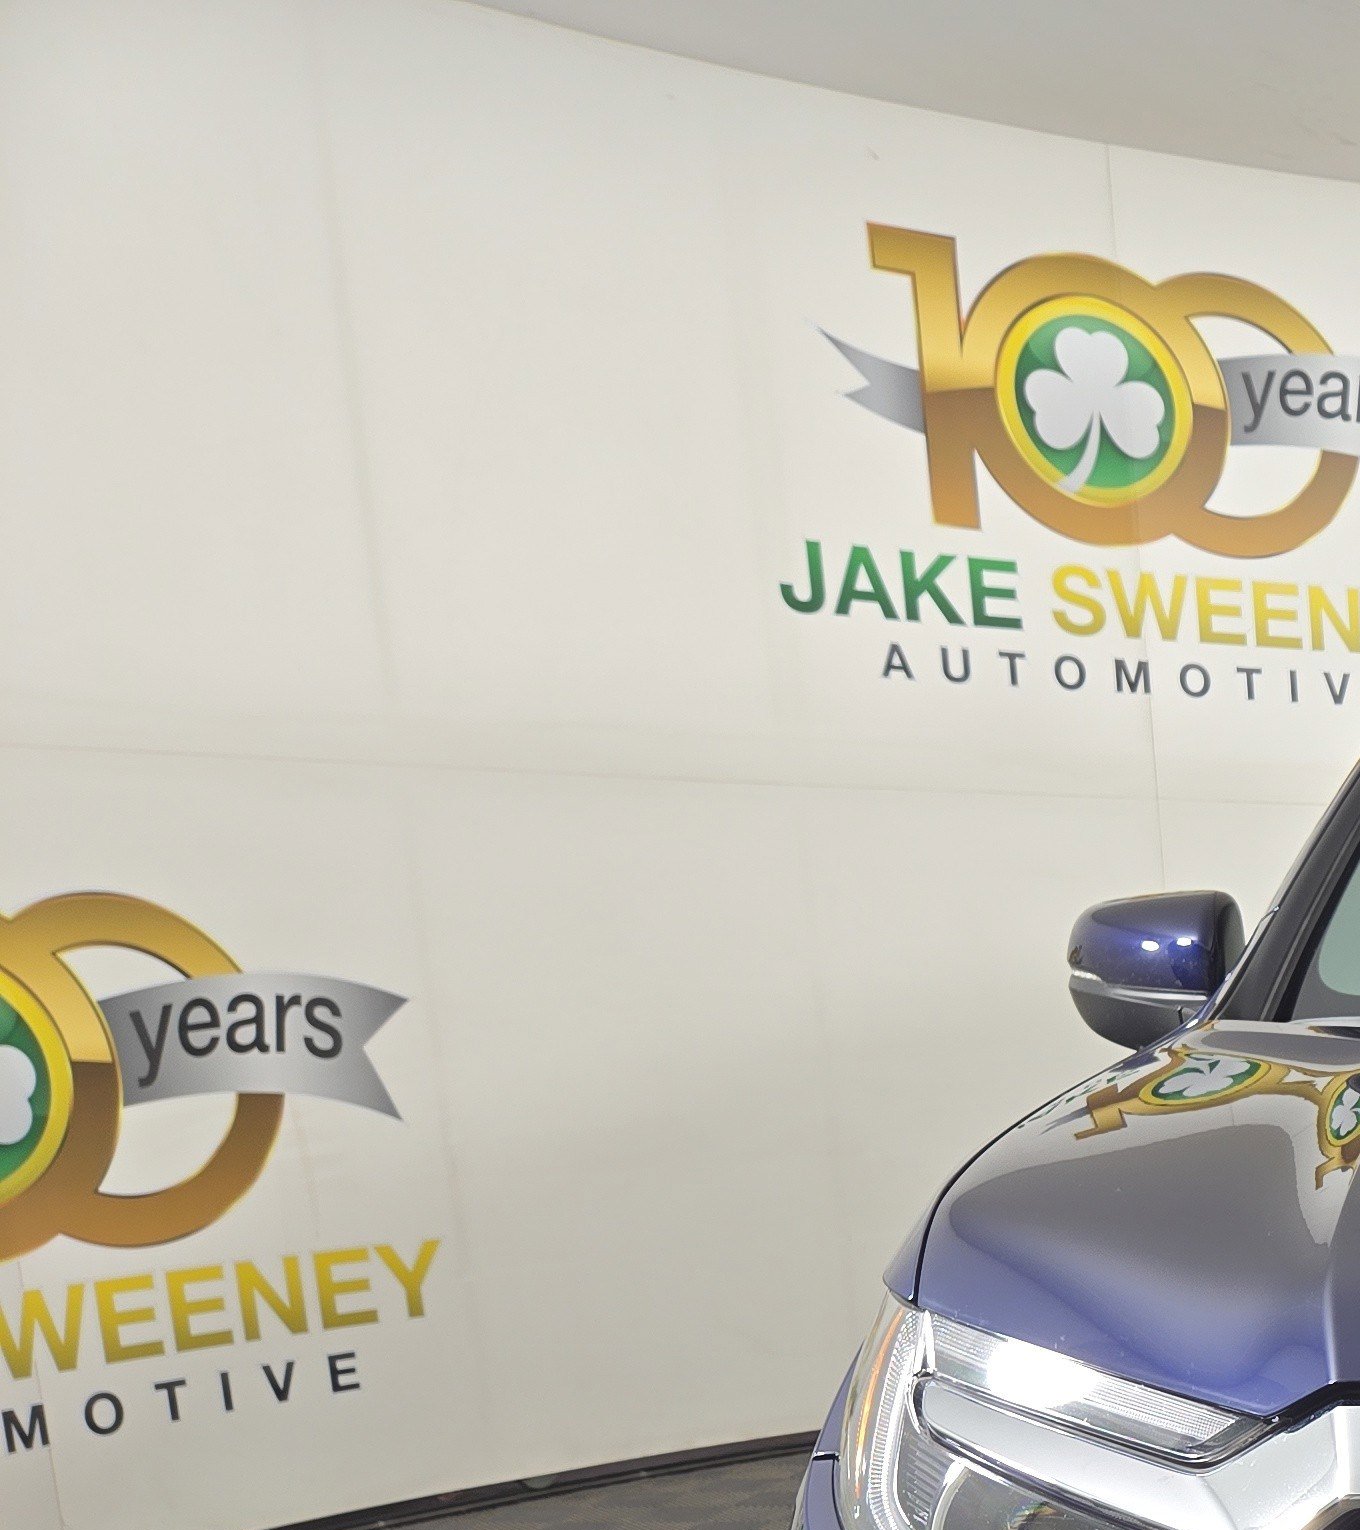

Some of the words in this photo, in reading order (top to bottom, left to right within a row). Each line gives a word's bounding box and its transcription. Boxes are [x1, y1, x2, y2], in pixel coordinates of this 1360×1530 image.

[866, 221, 1360, 559] 100
[780, 539, 1024, 630] JAKE
[130, 992, 343, 1087] years
